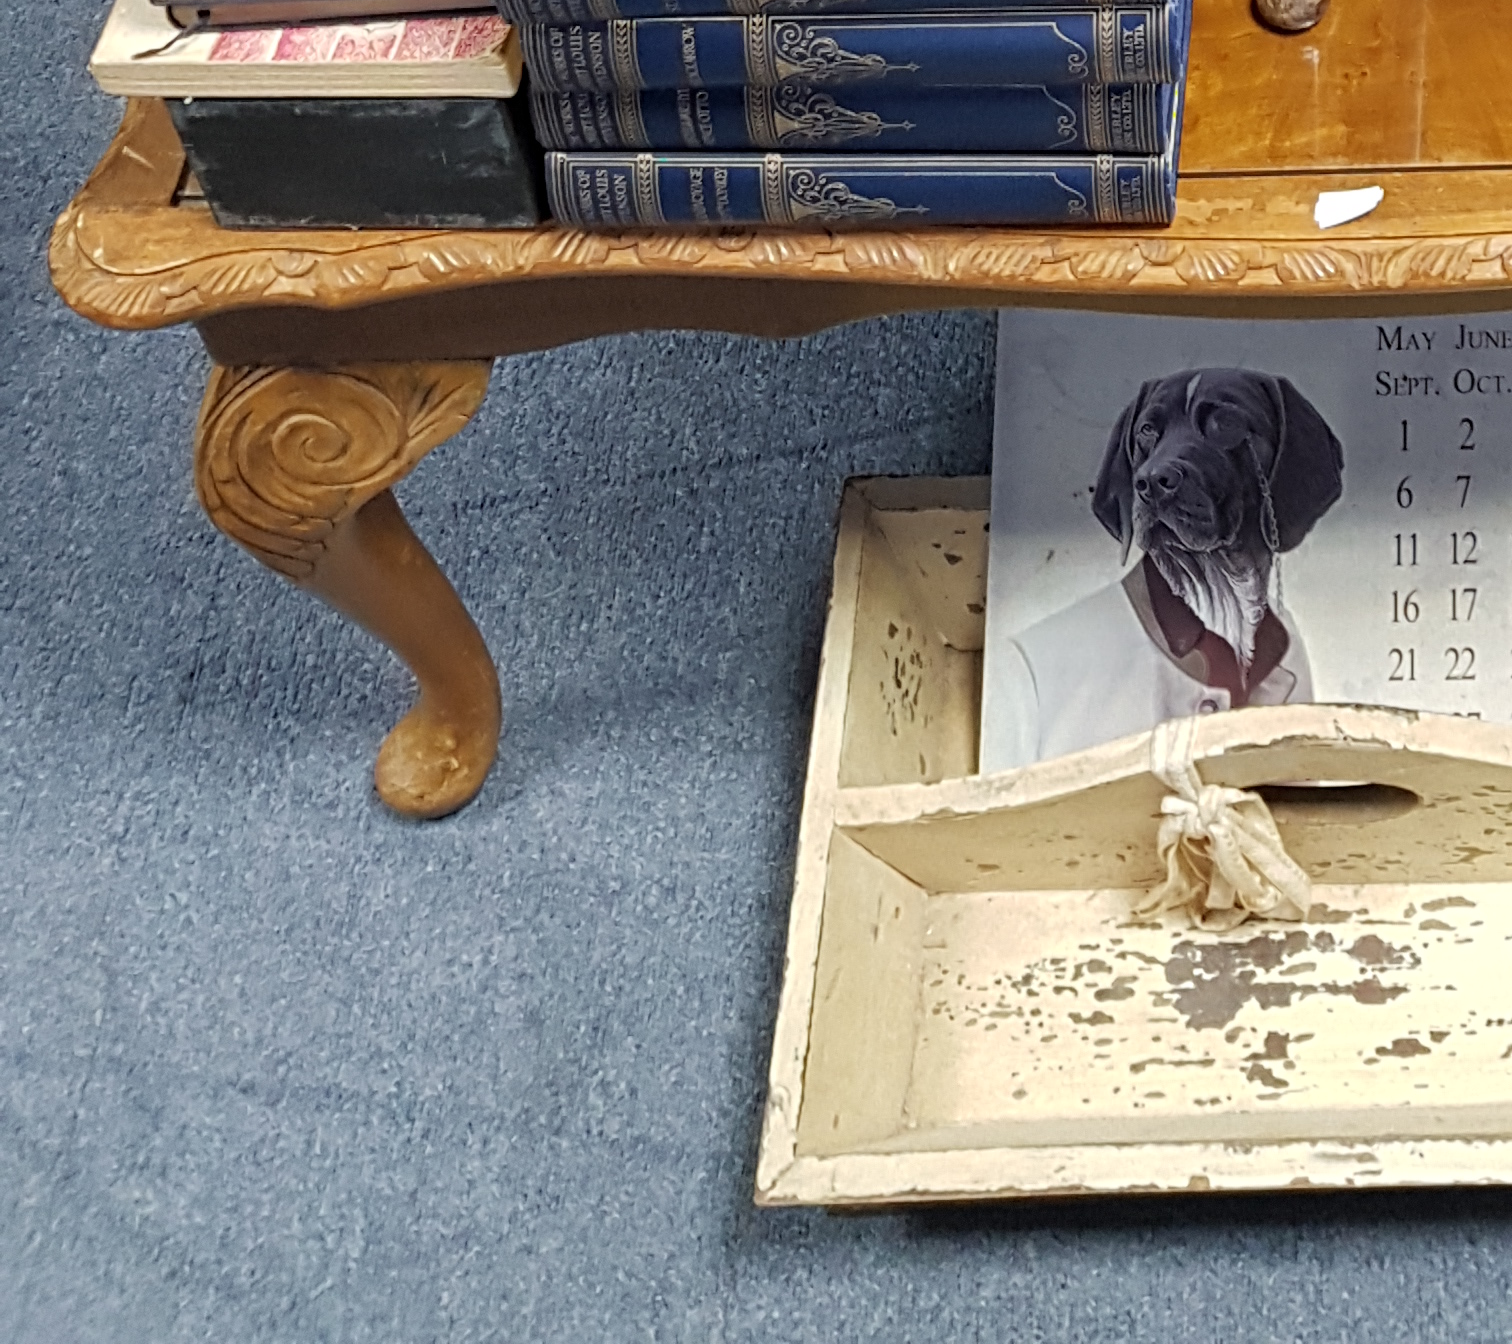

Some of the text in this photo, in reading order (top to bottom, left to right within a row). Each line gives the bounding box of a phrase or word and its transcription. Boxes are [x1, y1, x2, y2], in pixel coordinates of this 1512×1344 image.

[549, 27, 564, 47] OF
[1120, 26, 1136, 80] ERLEY
[1110, 92, 1124, 148] VERLEY
[576, 169, 591, 189] OF
[595, 169, 611, 207] LOUIS
[1376, 325, 1437, 351] MAY
[1375, 370, 1440, 396] SEPT.
[1453, 368, 1512, 394] OCT.
[1401, 419, 1408, 452] 1
[1460, 417, 1476, 451] 2
[1396, 475, 1413, 509] 6
[1456, 475, 1472, 508] 7
[1395, 533, 1417, 566] 11
[1451, 531, 1477, 565] 12
[1392, 589, 1420, 623] 16
[1451, 587, 1478, 621] 17
[1388, 647, 1416, 681] 21
[1445, 647, 1476, 681] 22
